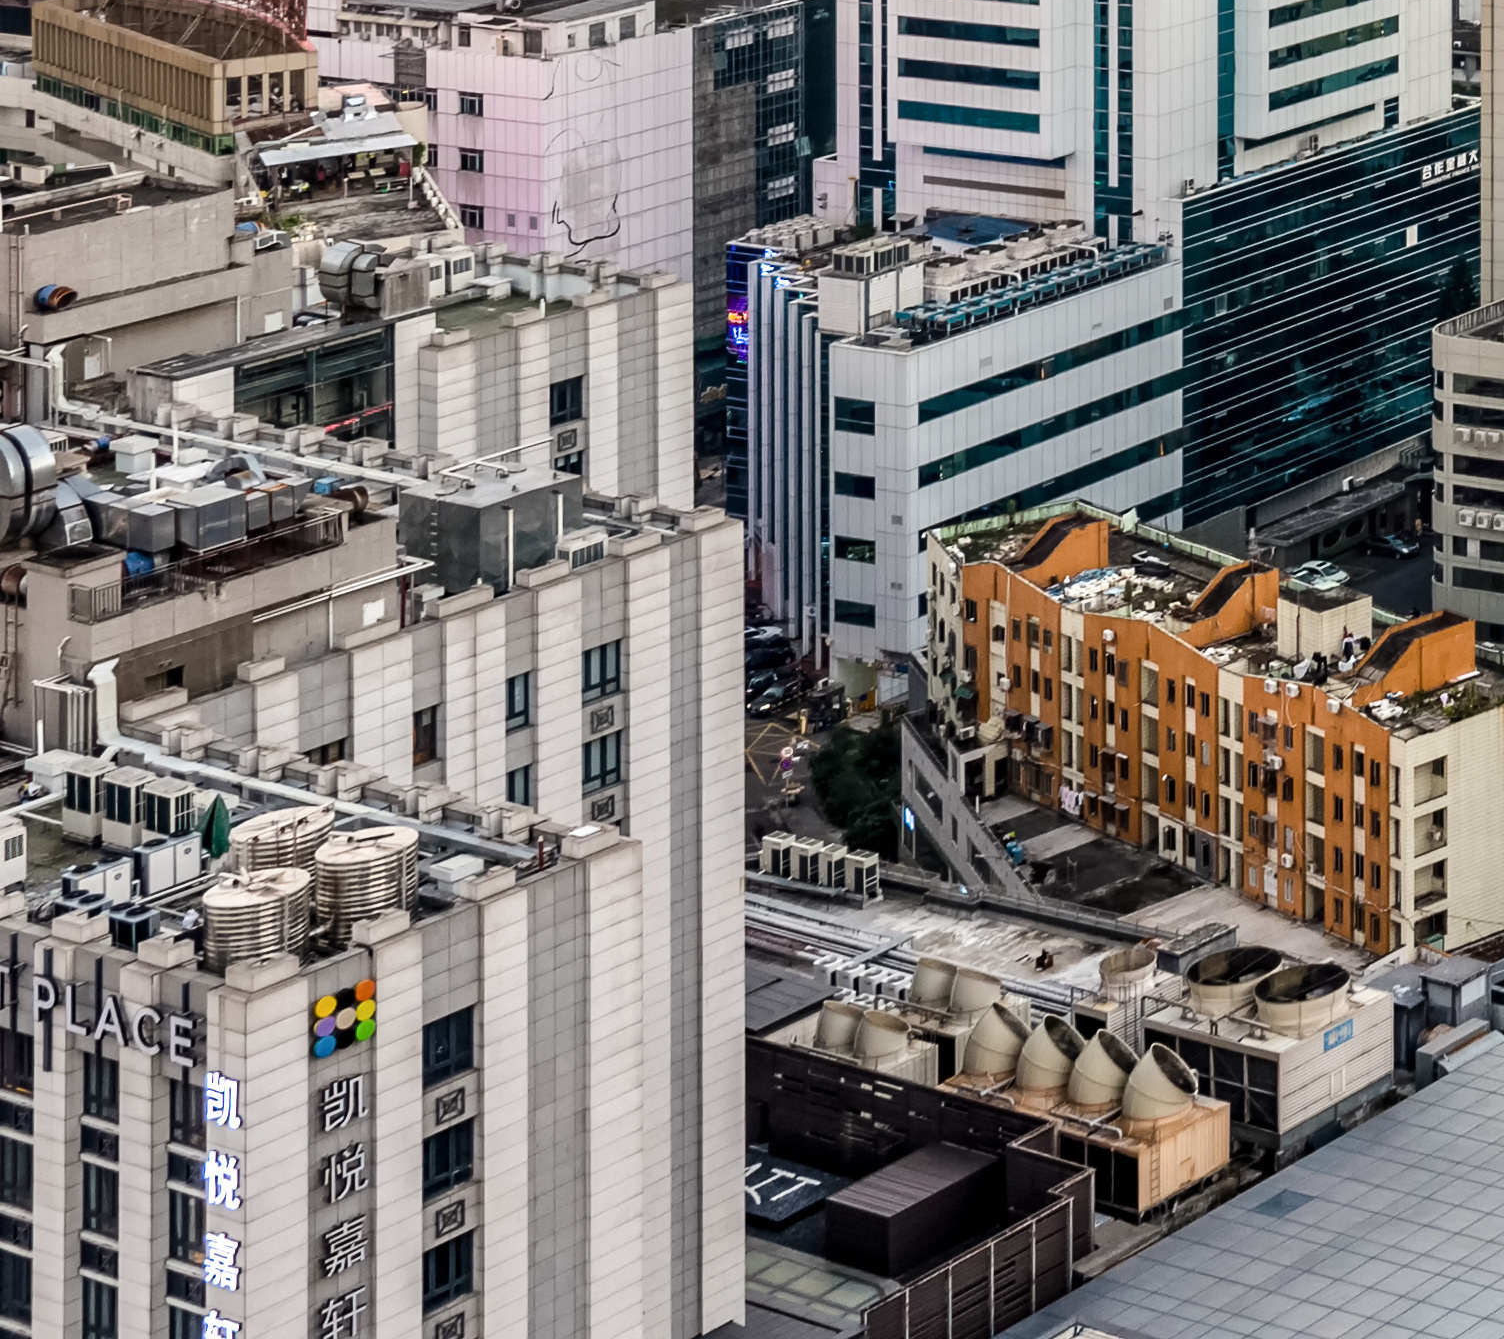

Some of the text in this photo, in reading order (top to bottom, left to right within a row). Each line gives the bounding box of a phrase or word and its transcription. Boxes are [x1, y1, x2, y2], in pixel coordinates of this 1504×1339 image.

[33, 975, 196, 1068] PLACE
[321, 1074, 368, 1339] 凯悦嘉轩
